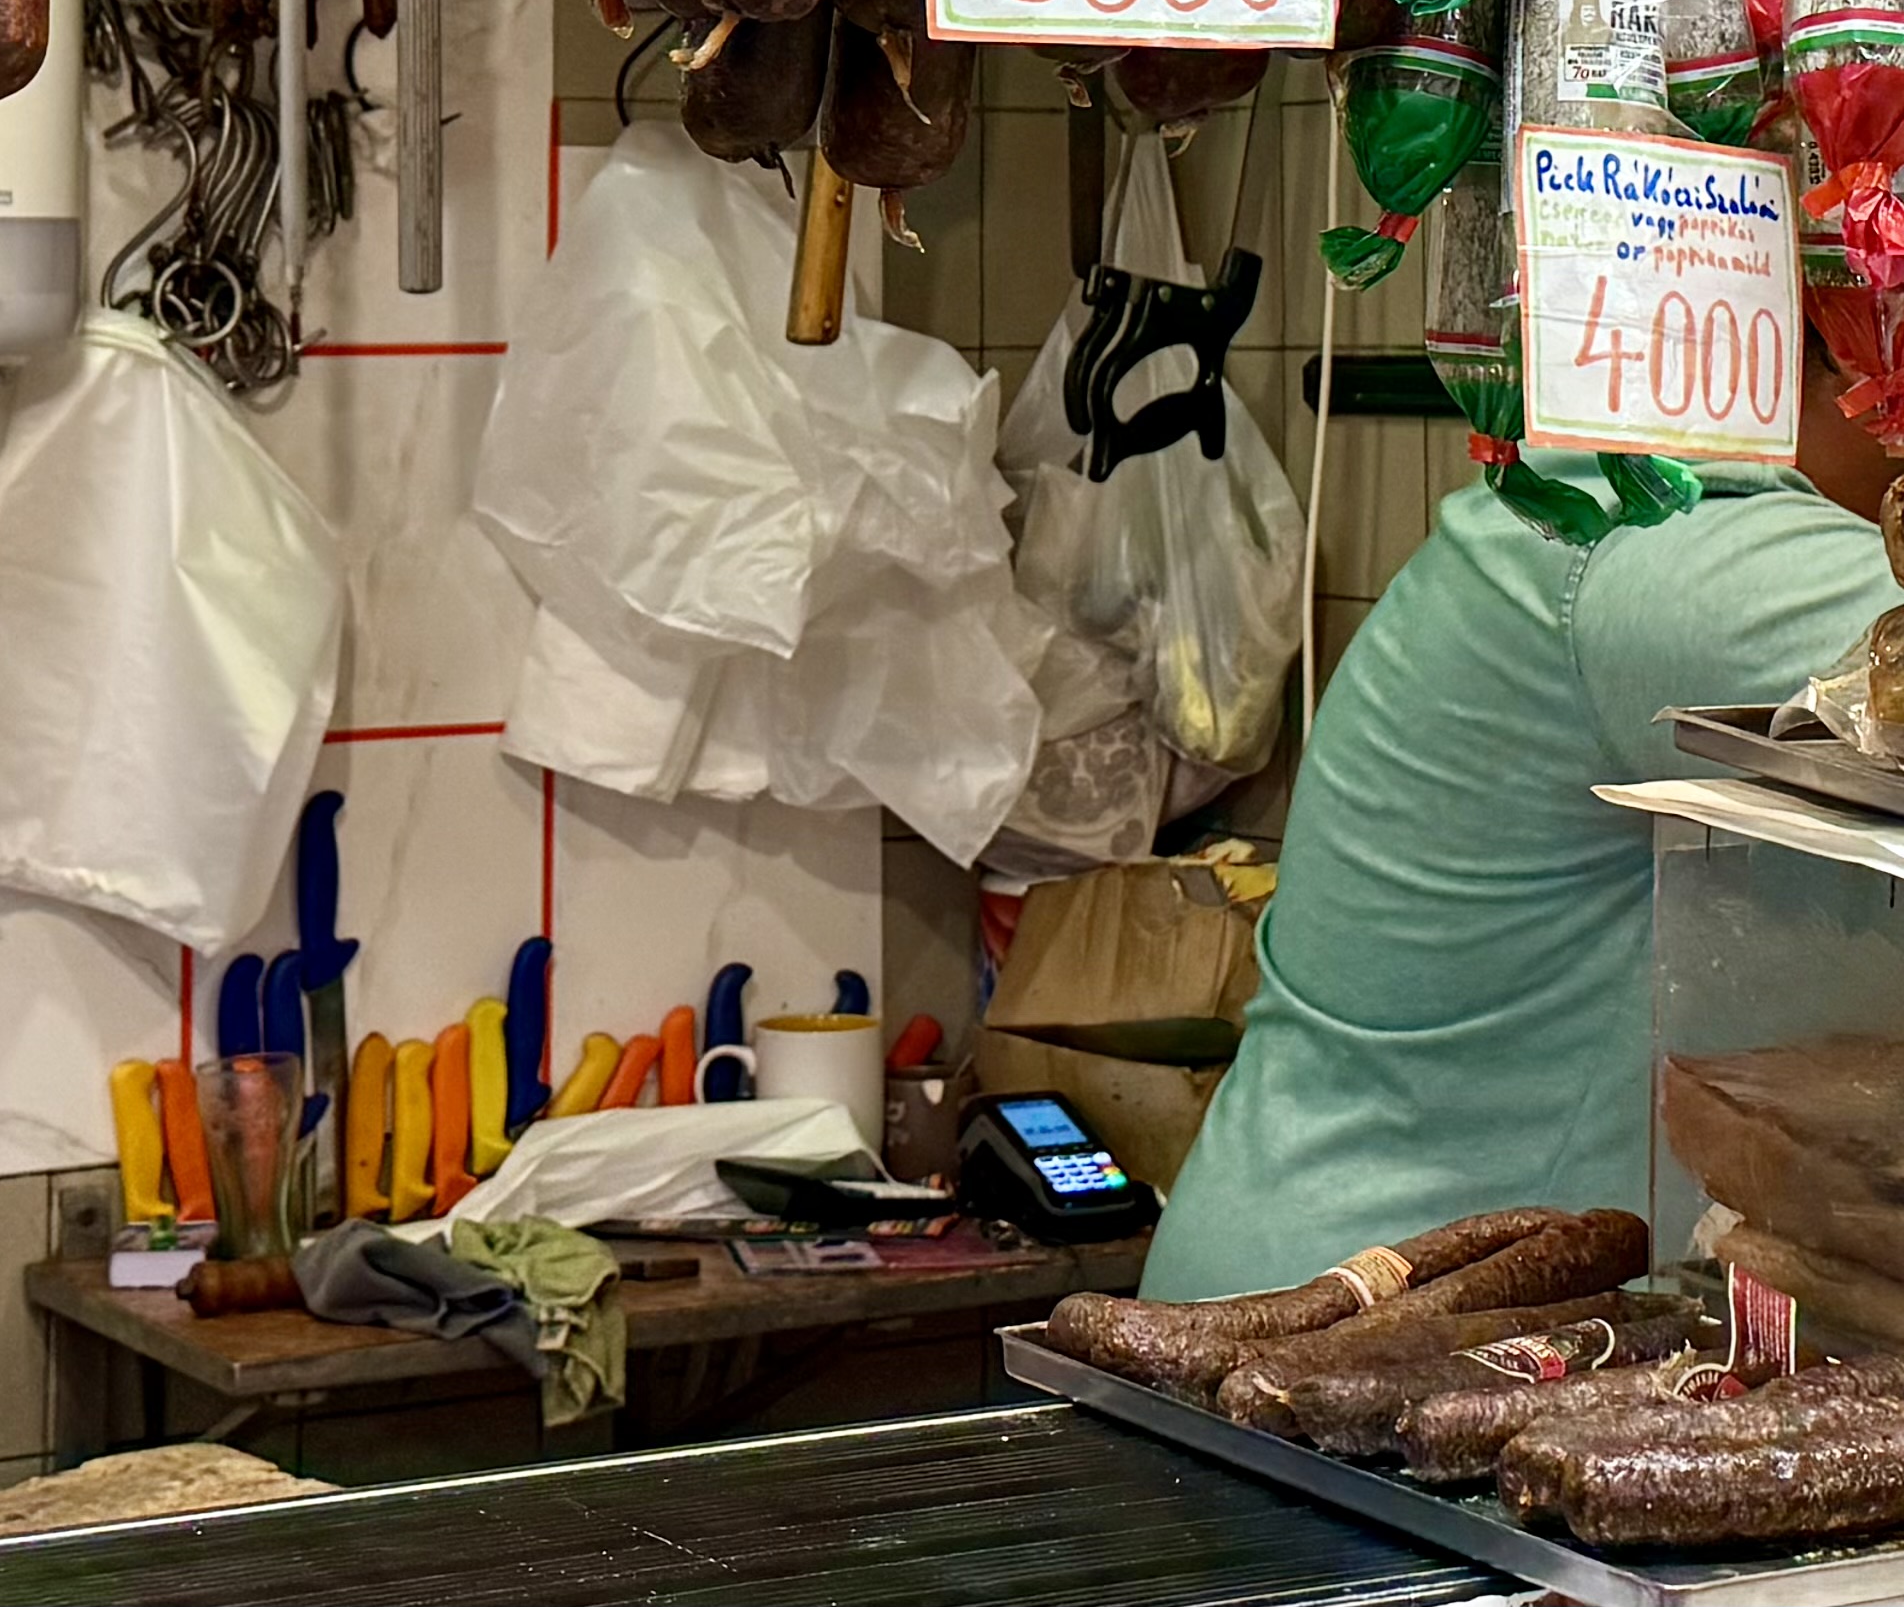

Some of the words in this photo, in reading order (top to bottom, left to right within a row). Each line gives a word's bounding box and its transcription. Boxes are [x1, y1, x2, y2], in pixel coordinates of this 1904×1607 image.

[1535, 149, 1595, 195] Pick
[1616, 241, 1646, 261] or
[1574, 275, 1784, 426] 4000
